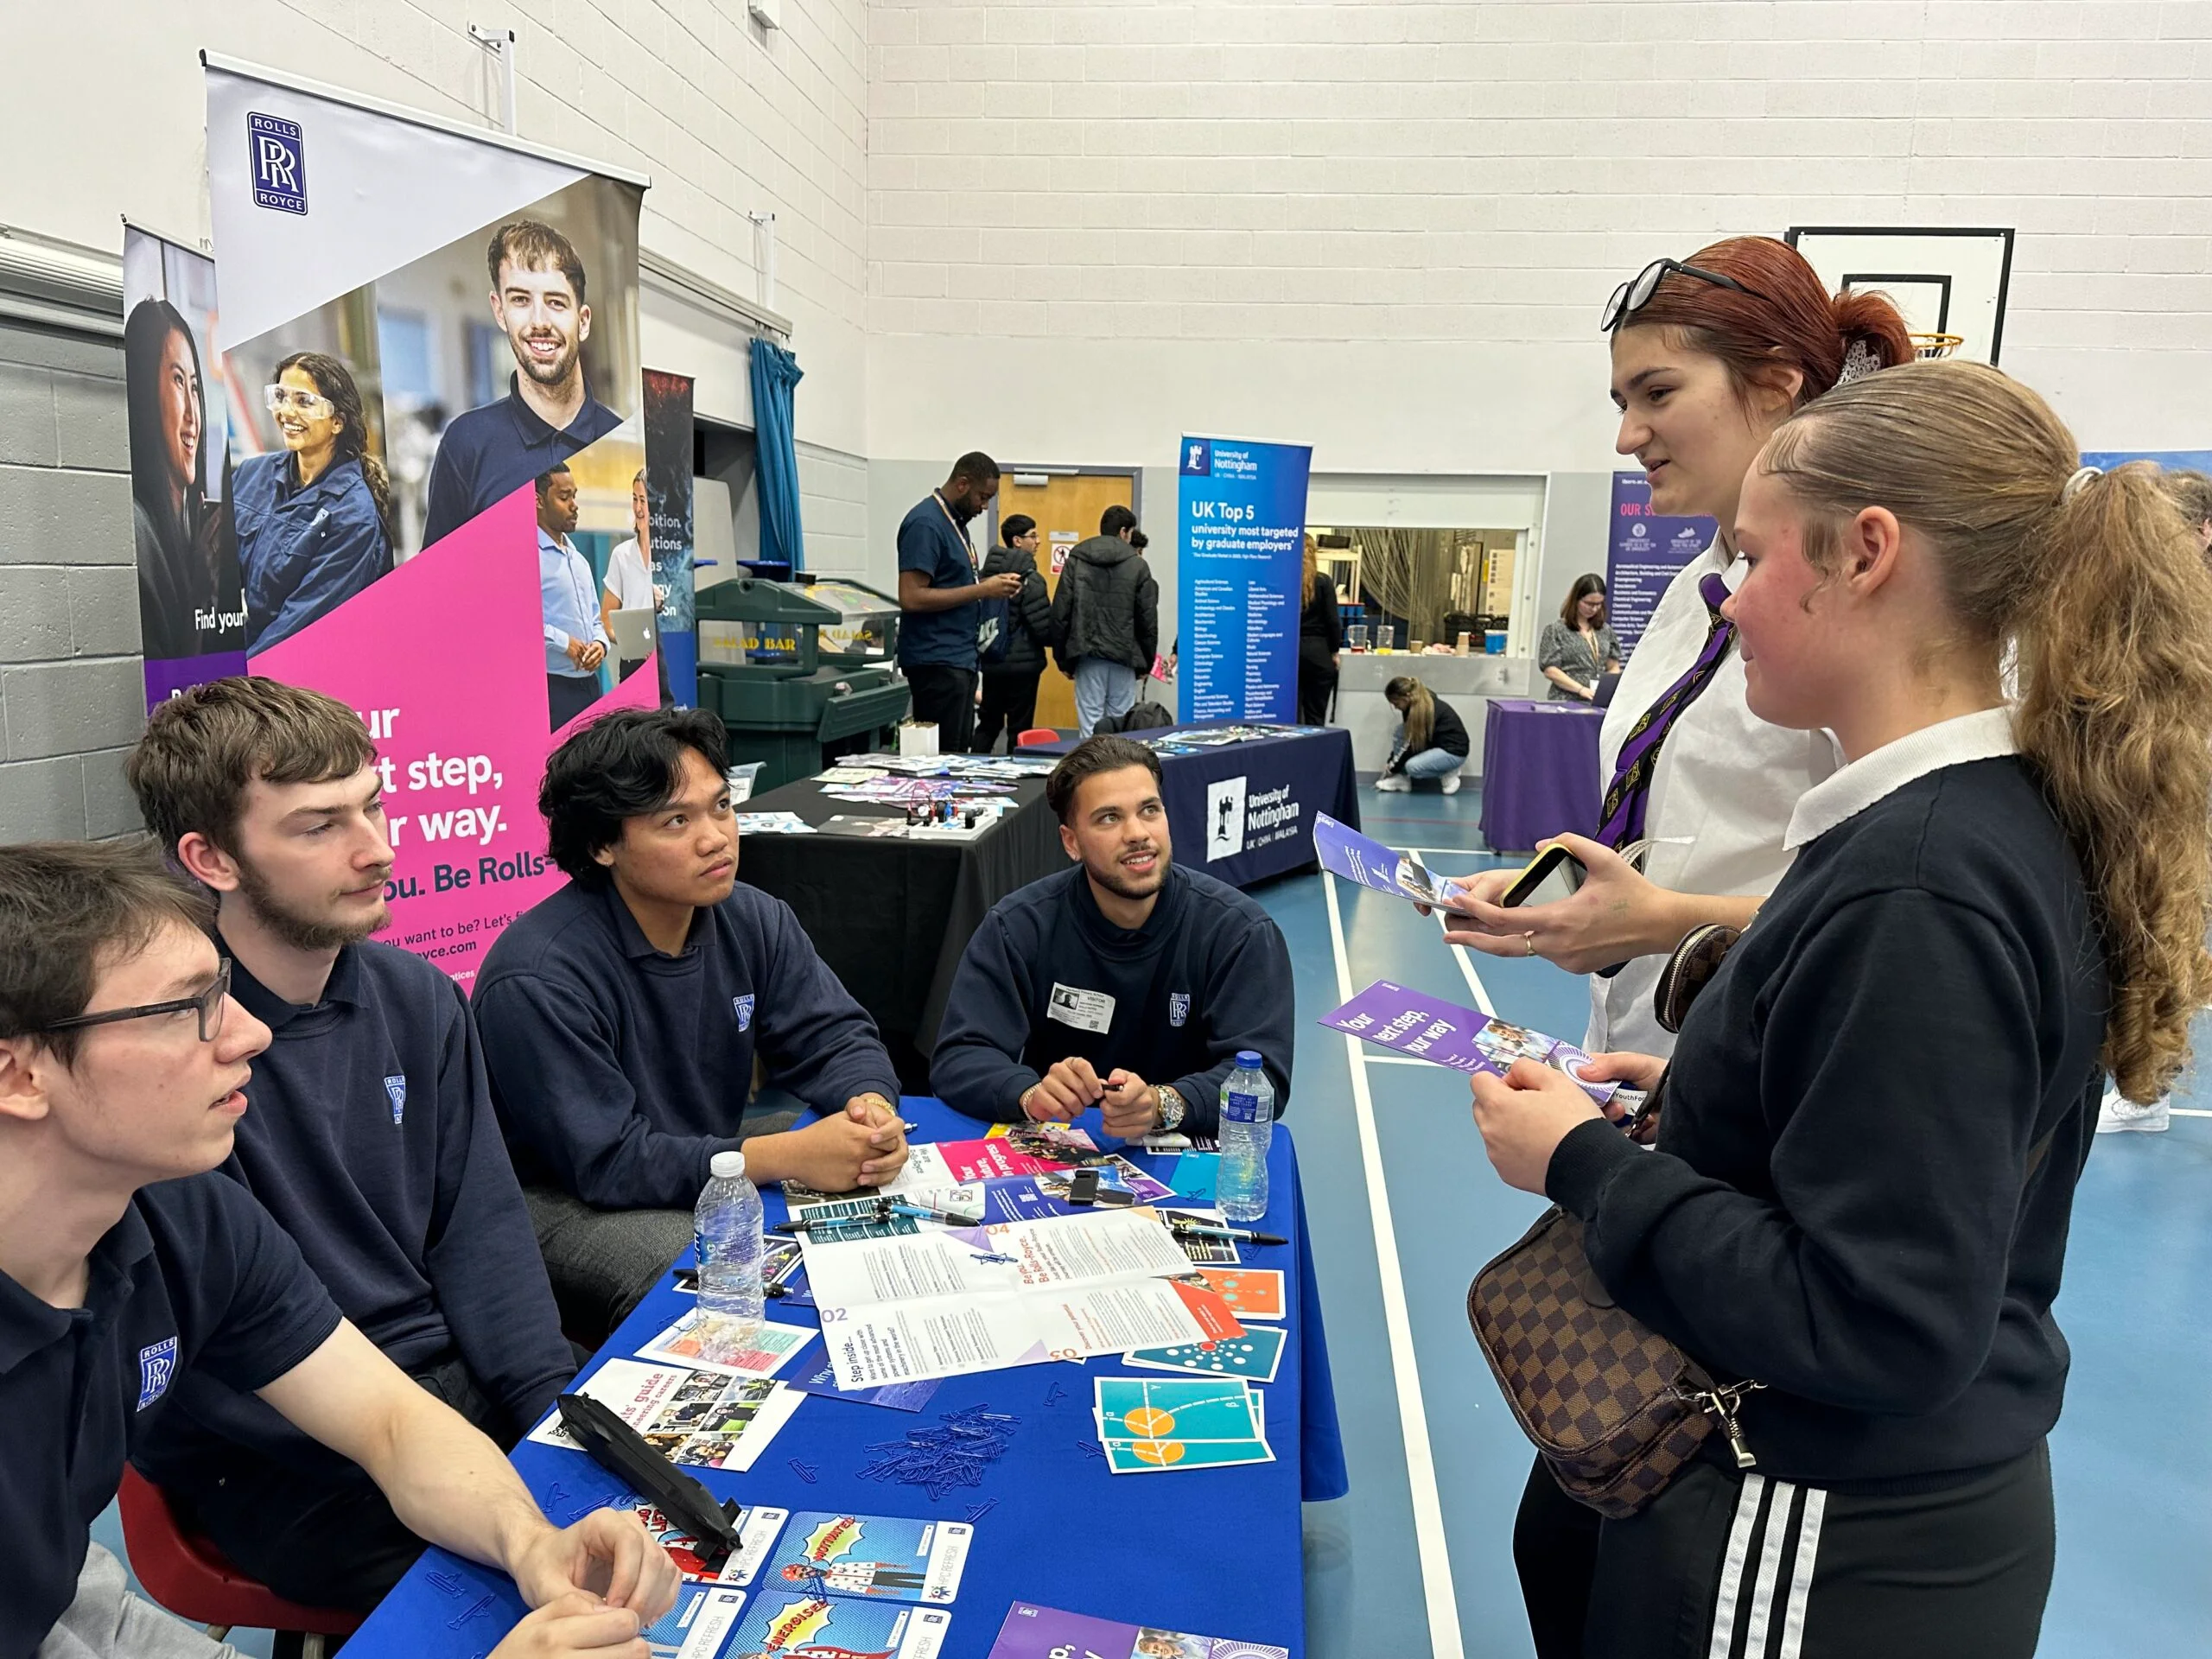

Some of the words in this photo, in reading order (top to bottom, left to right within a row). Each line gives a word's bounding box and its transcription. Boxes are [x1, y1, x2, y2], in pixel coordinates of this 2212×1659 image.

[254, 118, 296, 137] ROLLS
[260, 193, 302, 210] ROYCE
[1214, 449, 1242, 460] University
[1242, 451, 1249, 460] of
[1214, 459, 1258, 473] Nottingham
[1192, 500, 1215, 518] UK
[1217, 502, 1243, 523] Top
[1245, 505, 1255, 520] 5
[1620, 504, 1642, 516] OUR
[1192, 523, 1236, 537] university
[1238, 526, 1260, 536] most
[1261, 526, 1299, 539] targeted
[651, 537, 683, 550] utions
[1192, 536, 1205, 550] by
[1206, 537, 1245, 550] graduate
[194, 607, 216, 630] Find
[218, 612, 244, 634] your
[714, 637, 759, 649] SALAD
[765, 638, 796, 651] BAR
[358, 708, 400, 740] ur
[408, 753, 503, 794] step,
[1249, 788, 1281, 808] University
[1282, 784, 1290, 799] of
[418, 805, 507, 845] way.
[1248, 802, 1299, 831] Nottingham
[384, 876, 426, 901] ou.
[435, 864, 471, 893] Be
[480, 851, 556, 885] Rolls-
[384, 938, 400, 948] ou
[405, 930, 436, 944] want
[441, 927, 454, 938] to
[458, 919, 480, 934] be?
[484, 913, 512, 929] Let's
[416, 940, 477, 960] yce.com
[1336, 1013, 1375, 1031] Your
[1372, 1024, 1404, 1042] next
[1392, 1010, 1430, 1031] step,
[1426, 1019, 1457, 1040] way
[1615, 1092, 1645, 1102] YouthFoc
[985, 1143, 1014, 1171] progress
[960, 1166, 977, 1180] Your
[985, 1224, 1010, 1236] 04
[1023, 1274, 1034, 1284] Be
[1039, 1272, 1050, 1283] Be
[821, 1308, 848, 1323] 02
[865, 1324, 877, 1344] advanced
[144, 1338, 174, 1357] ROLLS
[885, 1347, 896, 1365] systems
[865, 1356, 874, 1365] get
[809, 1368, 834, 1384] Why
[851, 1364, 863, 1382] Step
[891, 1366, 901, 1377] power
[634, 1373, 664, 1402] guide
[656, 1375, 677, 1398] careers
[751, 1530, 768, 1557] REFRESH
[813, 1516, 855, 1560] MOTIVATED
[944, 1546, 959, 1569] REFRESH
[702, 1617, 725, 1648] REFRESH
[766, 1599, 828, 1653] ENERGISED
[912, 1636, 933, 1659] FRESH
